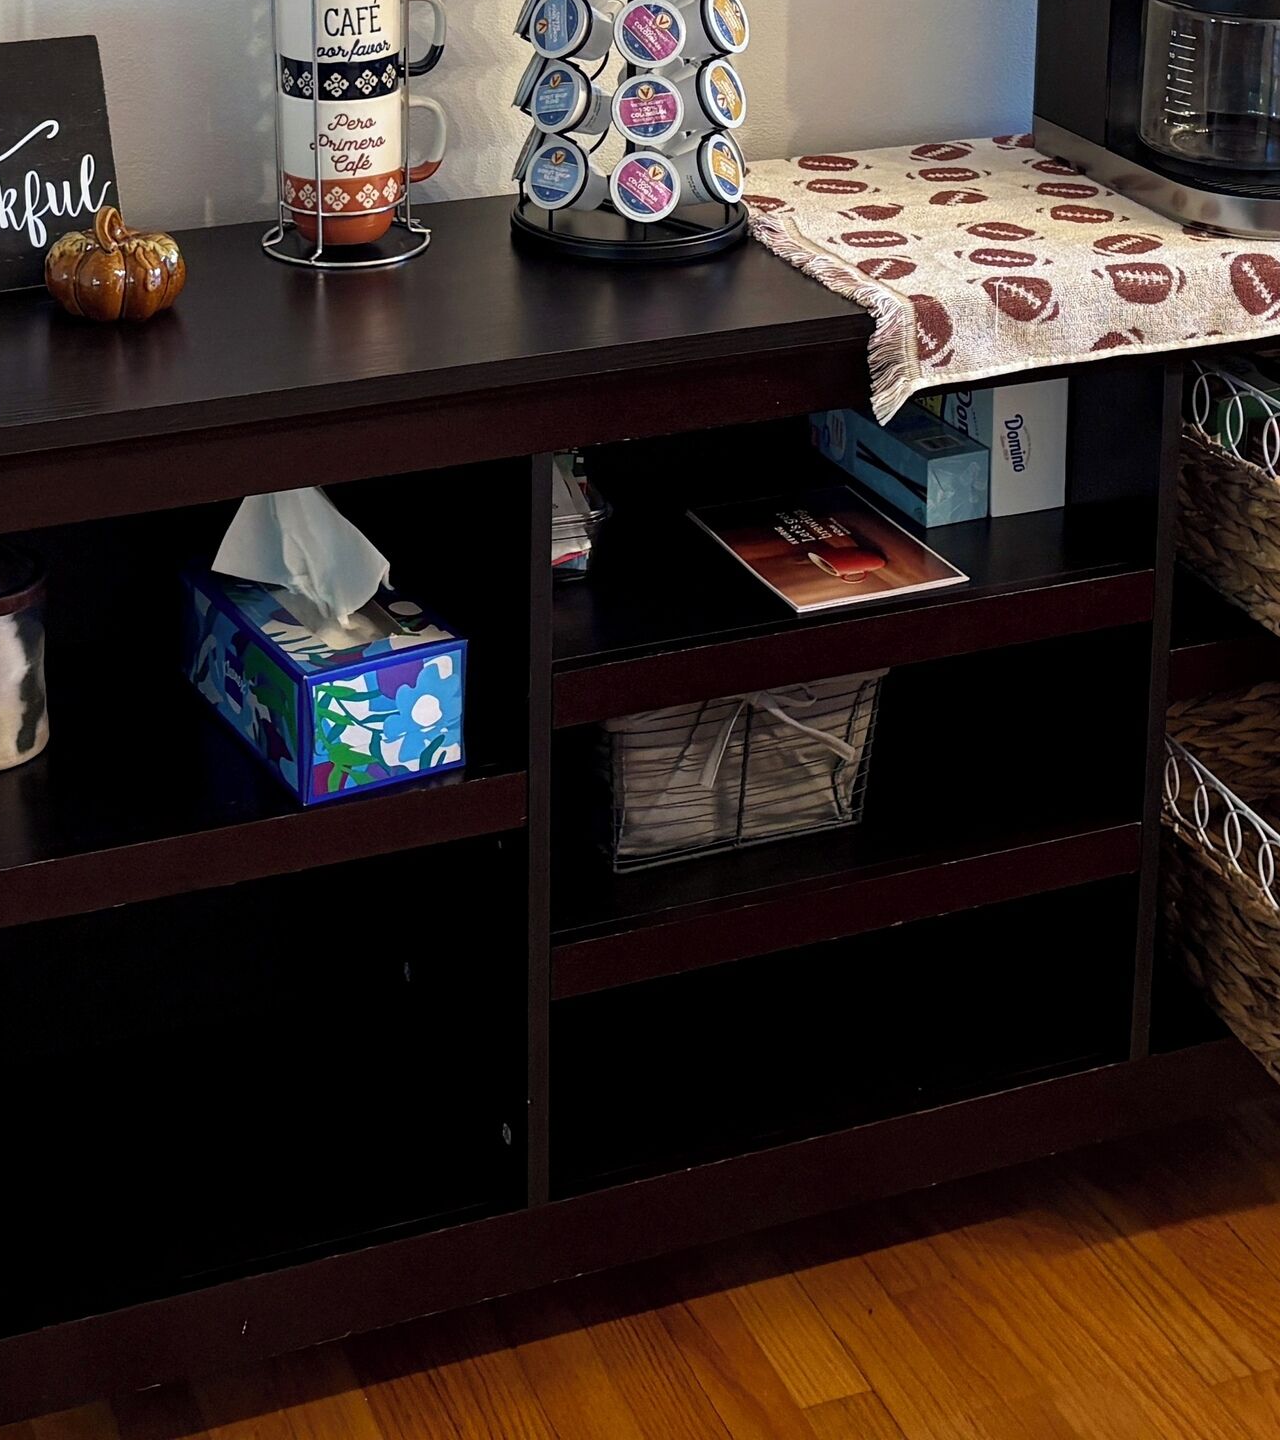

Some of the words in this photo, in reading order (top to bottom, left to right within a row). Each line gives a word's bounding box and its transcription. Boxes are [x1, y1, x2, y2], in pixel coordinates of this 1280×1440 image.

[324, 0, 381, 37] CAFÉ
[348, 38, 392, 61] favor
[327, 113, 377, 131] Pero
[309, 133, 386, 151] Primero
[330, 153, 373, 177] Café
[1004, 413, 1026, 473] Domino
